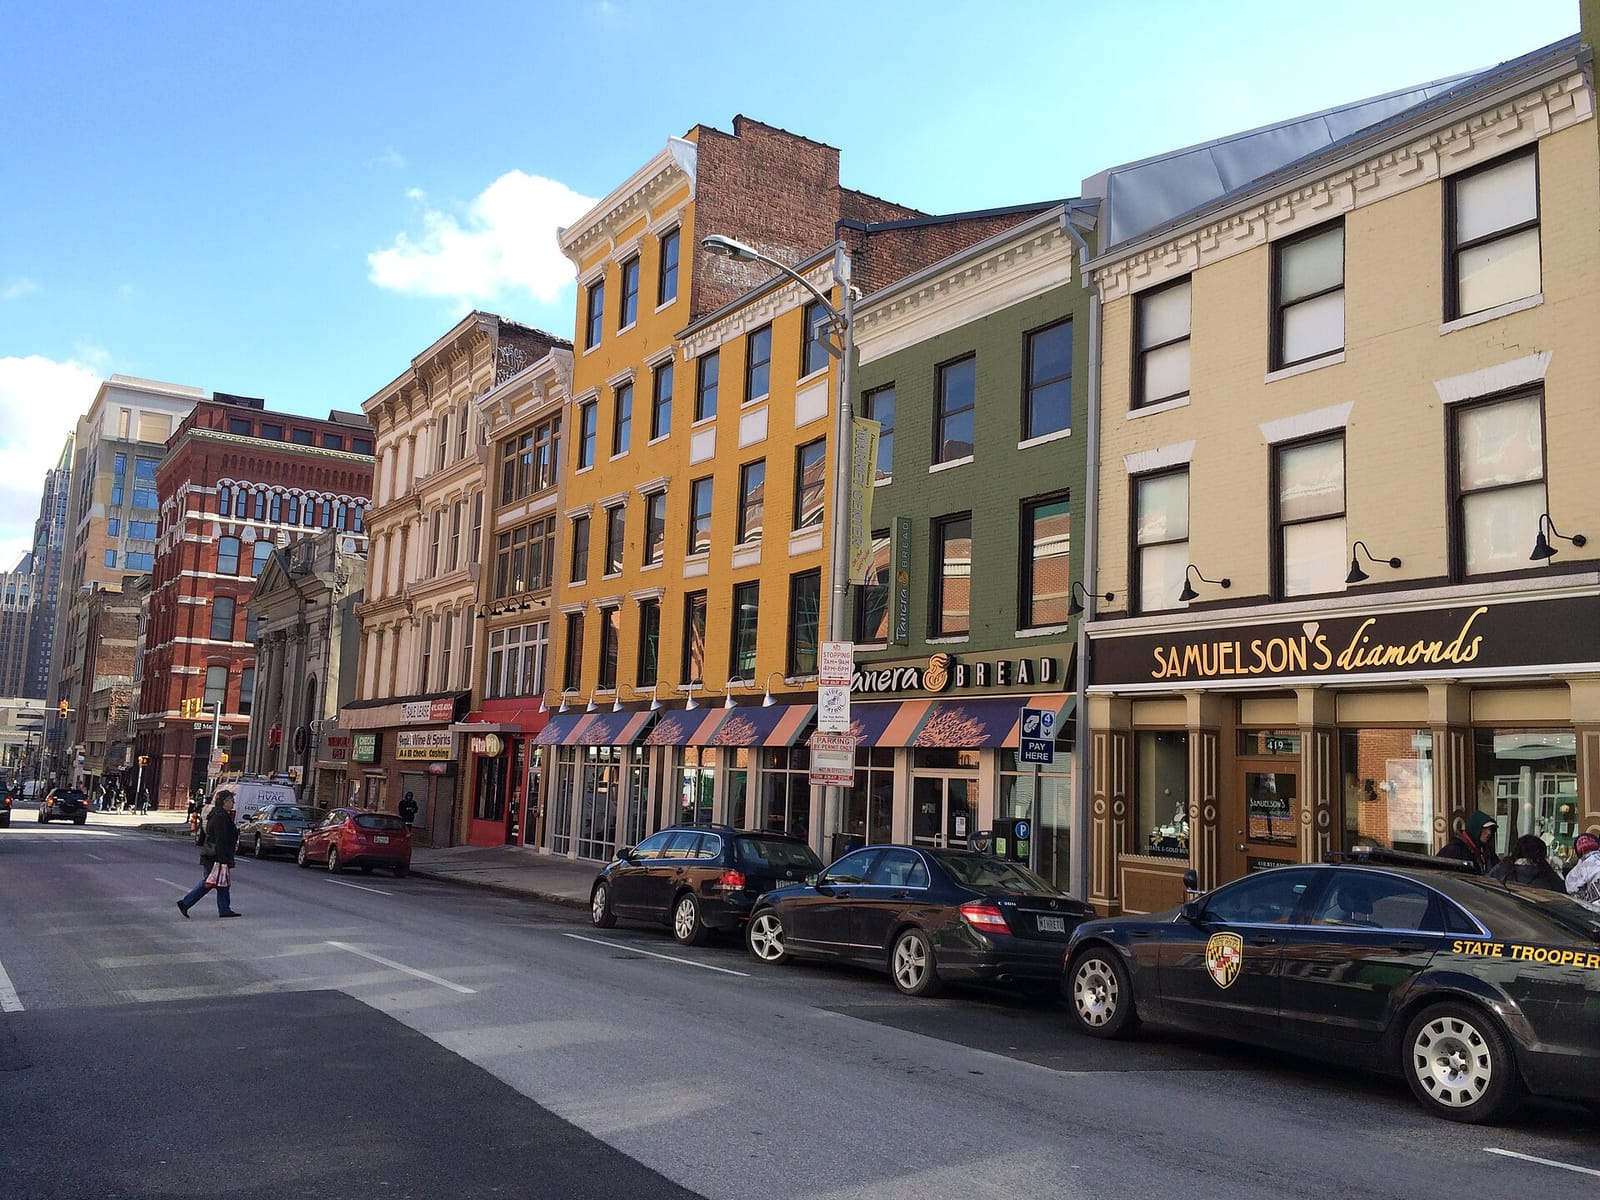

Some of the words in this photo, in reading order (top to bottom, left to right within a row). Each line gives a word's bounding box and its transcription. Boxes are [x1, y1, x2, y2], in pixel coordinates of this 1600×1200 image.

[853, 429, 870, 488] MARKET
[852, 490, 866, 546] CENTER
[901, 522, 910, 567] BREAD
[896, 588, 908, 641] Panera
[1151, 622, 1333, 679] SAMUELSON'S
[1336, 607, 1488, 671] diamonds
[850, 661, 919, 693] anera
[957, 657, 1050, 687] BREAD
[825, 688, 843, 697] VIDEO
[824, 704, 844, 713] PATROL
[411, 733, 426, 746] Wine
[426, 733, 432, 745] &
[433, 733, 451, 748] Spirits
[471, 737, 486, 753] Pita
[486, 737, 497, 753] Pit
[816, 737, 850, 745] PARKING
[1029, 742, 1046, 751] PAY
[1267, 741, 1284, 750] 419
[413, 749, 426, 757] Check
[429, 749, 449, 759] Cashing
[1025, 751, 1049, 761] HERE
[1452, 940, 1504, 957] STATE
[1511, 945, 1600, 969] TROOPER
